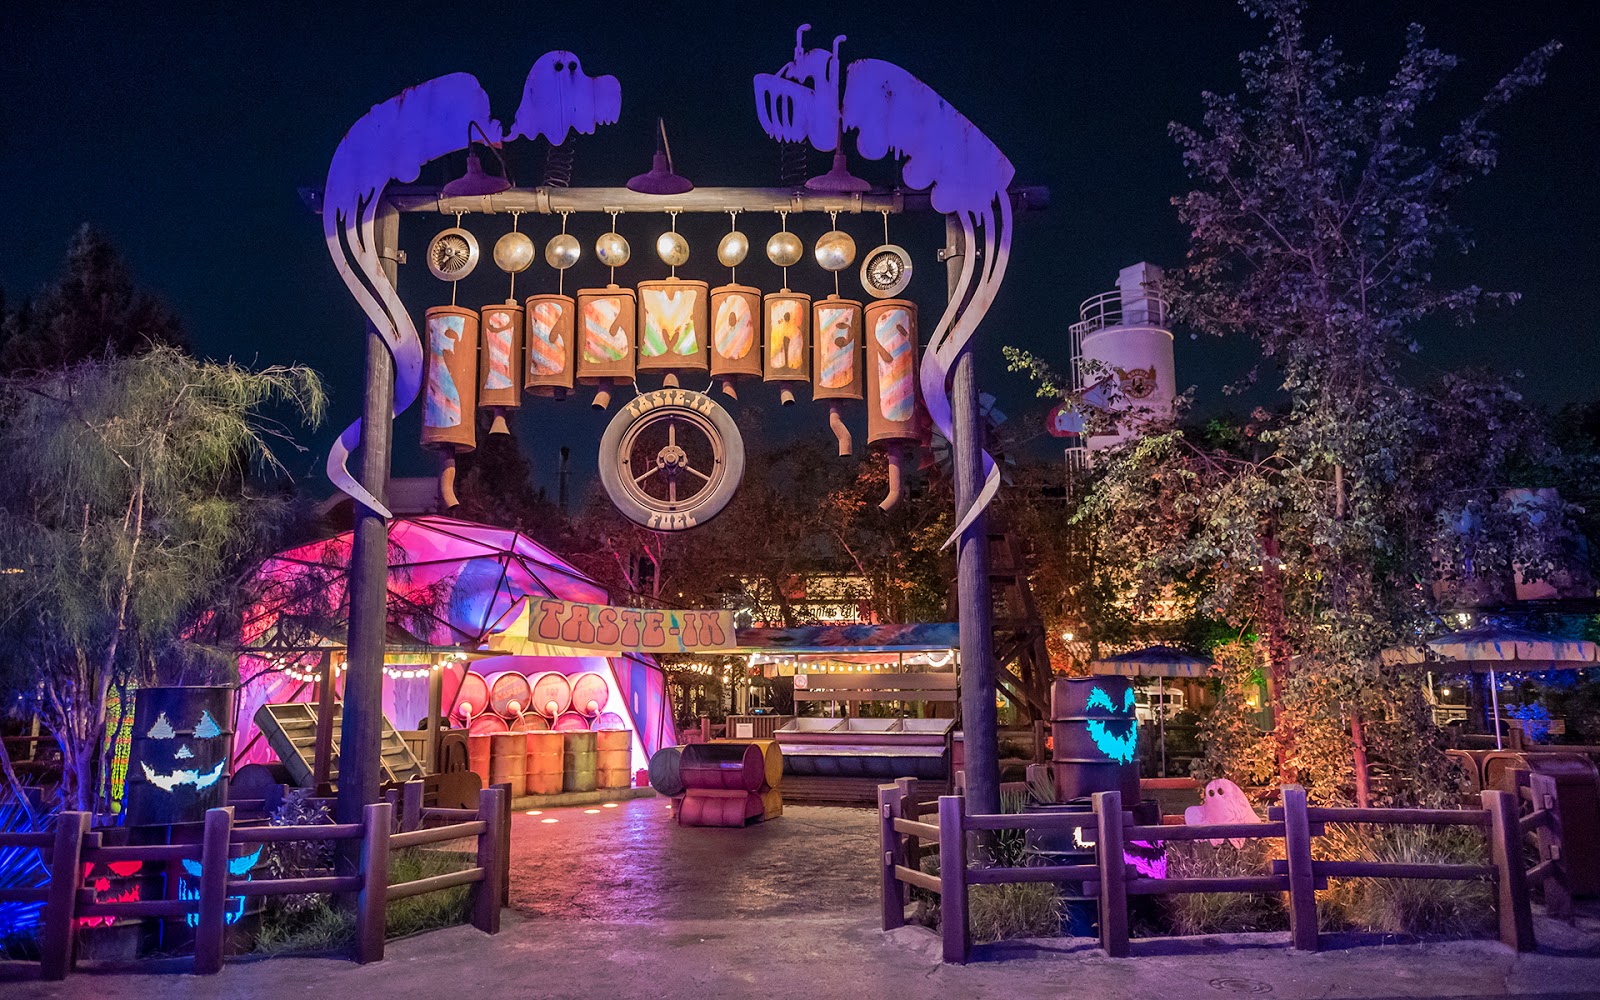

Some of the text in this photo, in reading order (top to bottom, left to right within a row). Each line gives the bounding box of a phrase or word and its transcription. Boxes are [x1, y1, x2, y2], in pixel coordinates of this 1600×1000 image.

[626, 390, 716, 419] TASTE-IN
[647, 511, 697, 530] FUEL
[538, 600, 726, 648] TASTE-IN
